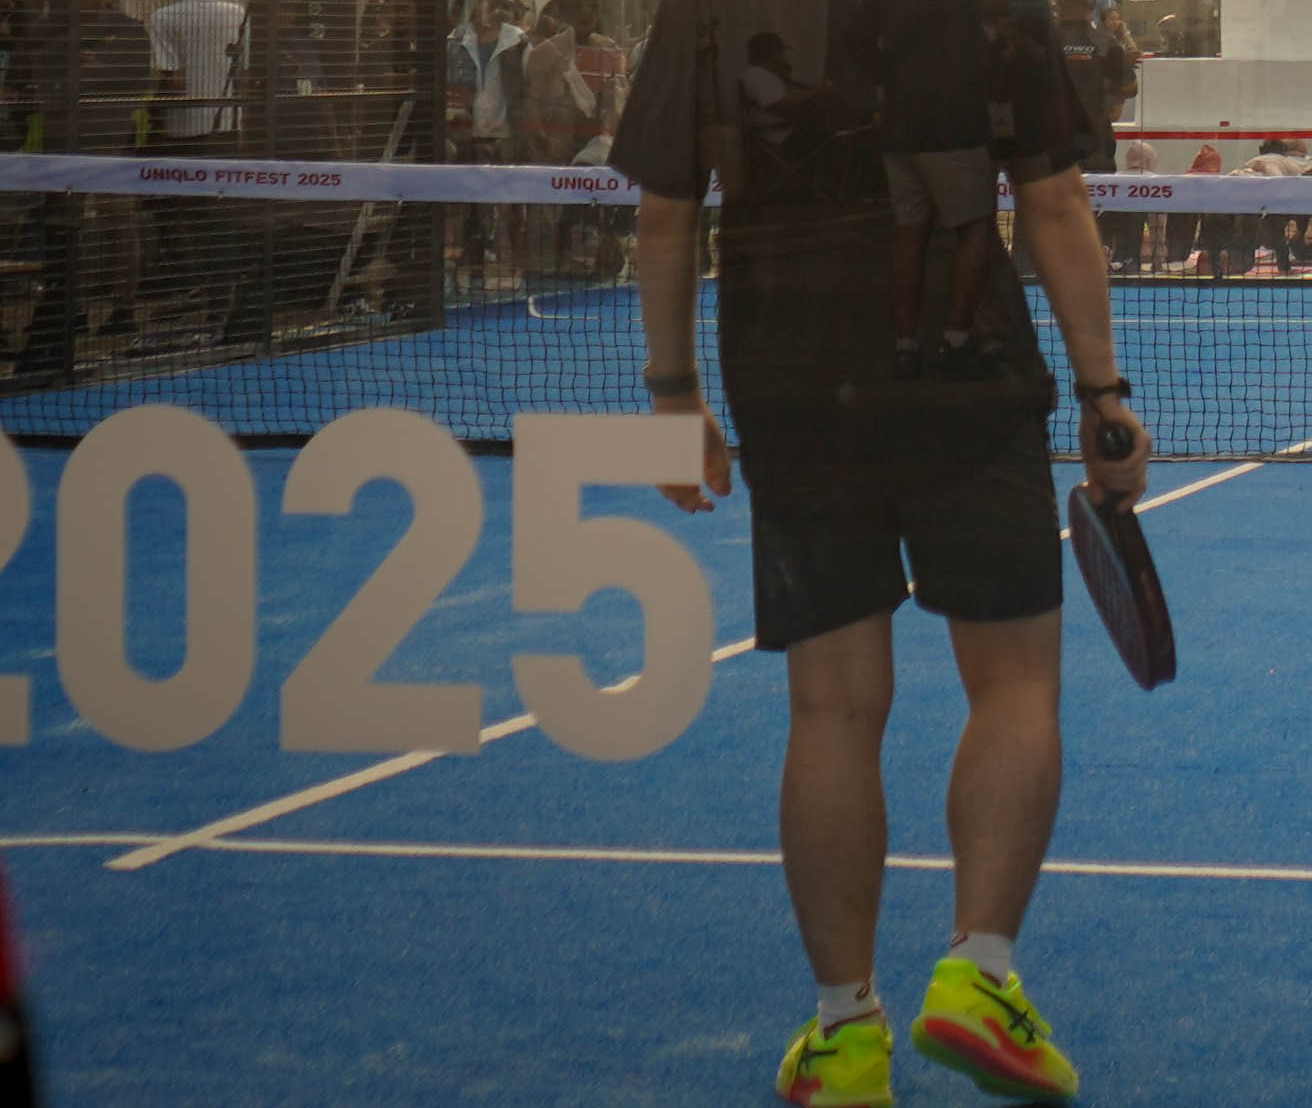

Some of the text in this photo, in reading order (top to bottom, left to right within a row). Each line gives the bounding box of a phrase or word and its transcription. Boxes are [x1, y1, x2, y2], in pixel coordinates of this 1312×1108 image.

[139, 168, 341, 187] UNIQLO FITFEST 2025
[551, 177, 619, 192] UNIQLO
[1127, 185, 1173, 198] 2025
[0, 403, 715, 762] 025
